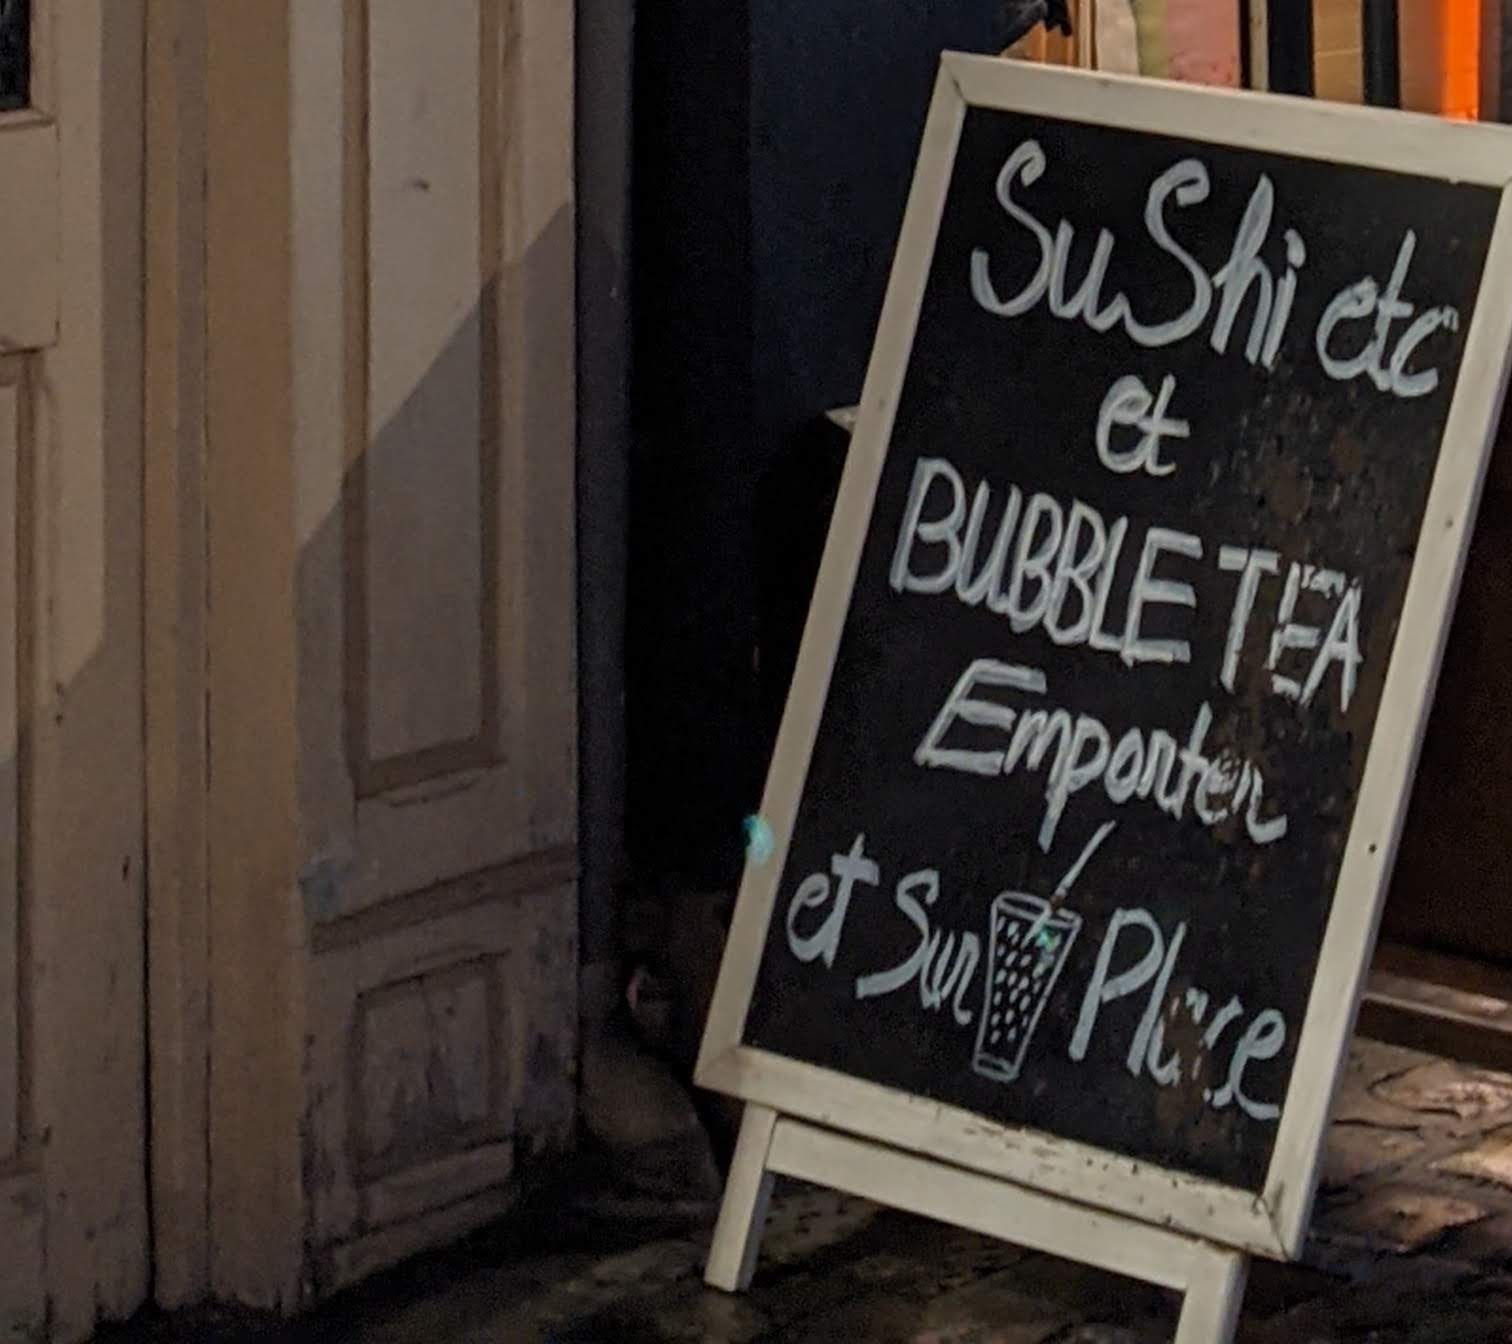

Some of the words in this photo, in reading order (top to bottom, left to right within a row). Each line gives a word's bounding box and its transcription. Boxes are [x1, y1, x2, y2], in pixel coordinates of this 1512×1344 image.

[1316, 230, 1462, 397] etc
[1095, 374, 1192, 476] et
[889, 456, 1204, 667] BUBBLE
[1217, 543, 1365, 712] TEA
[787, 832, 881, 970] et
